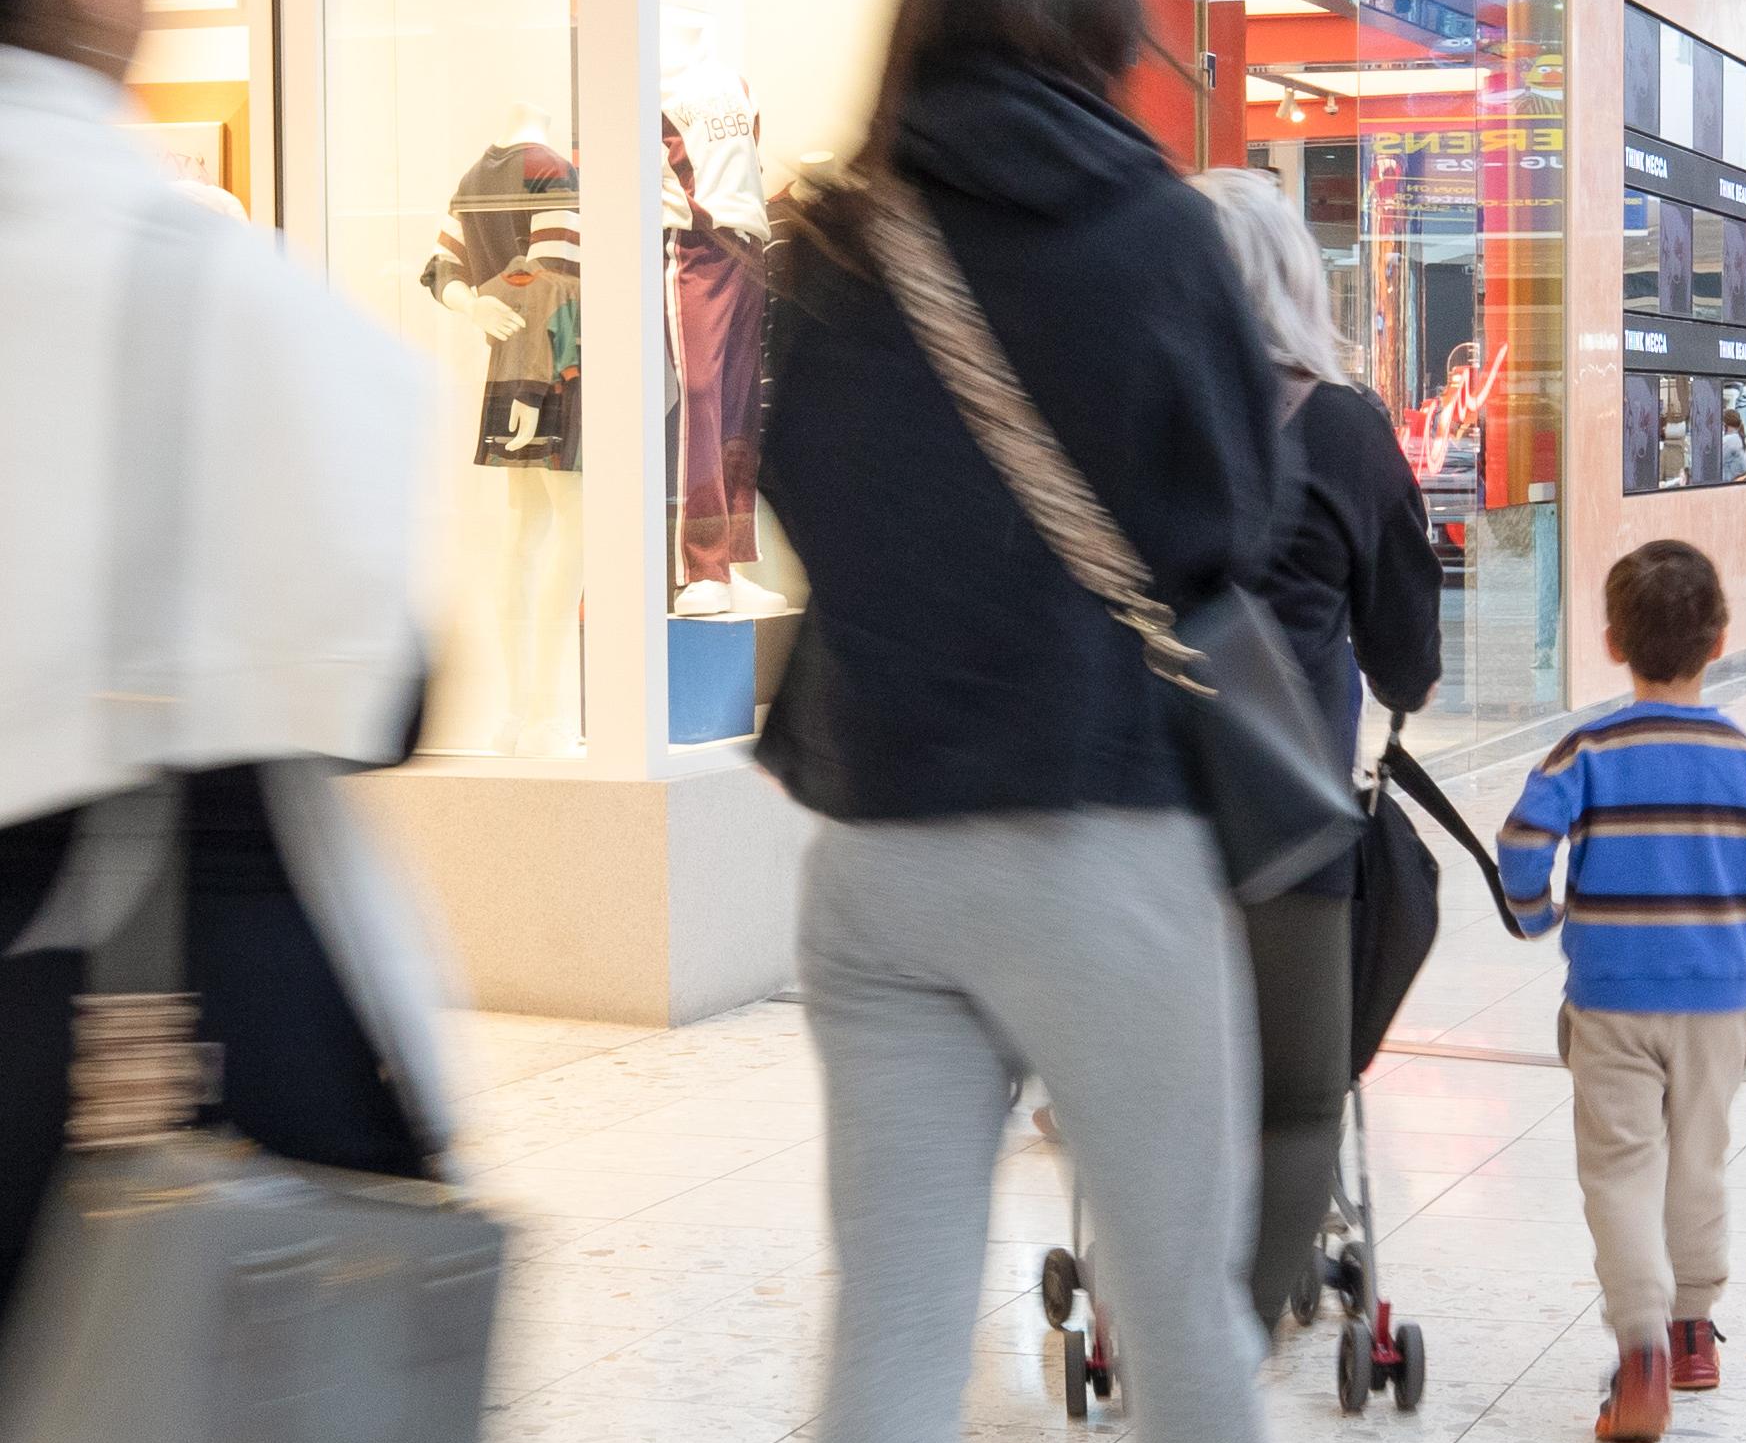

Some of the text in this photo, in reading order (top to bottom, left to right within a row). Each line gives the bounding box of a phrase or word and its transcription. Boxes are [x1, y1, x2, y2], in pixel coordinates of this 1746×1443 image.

[703, 113, 750, 142] 1996
[1625, 146, 1668, 178] THINK MECCA
[1719, 178, 1735, 201] THINK
[1625, 330, 1645, 351] THINK
[1645, 332, 1667, 354] MECCA
[1718, 340, 1735, 360] THINK
